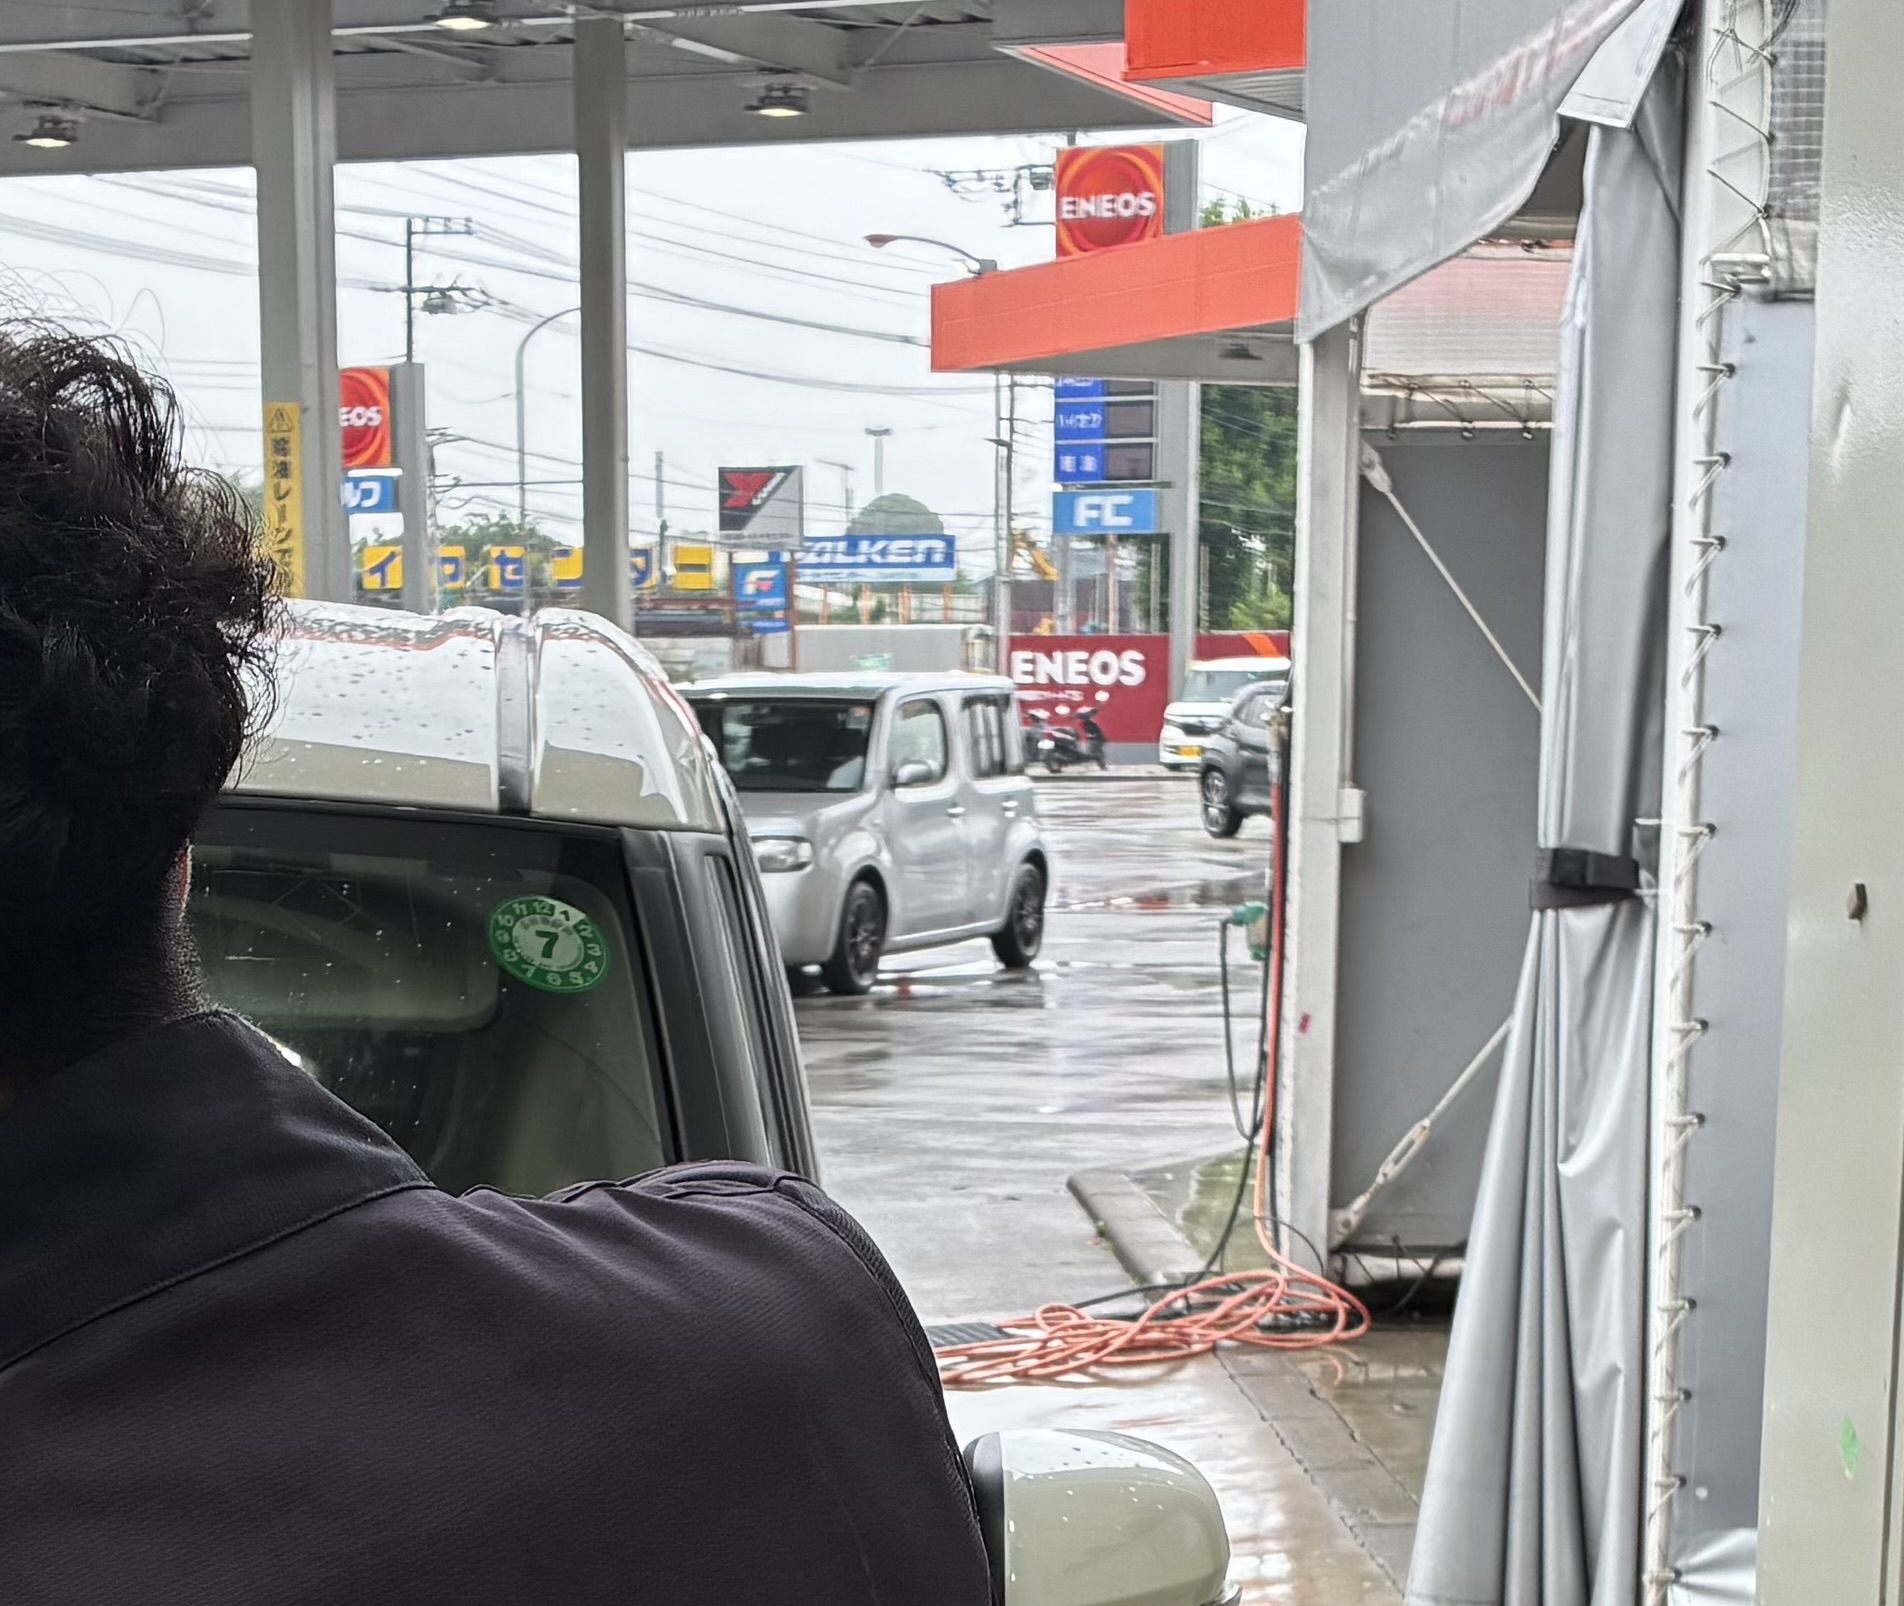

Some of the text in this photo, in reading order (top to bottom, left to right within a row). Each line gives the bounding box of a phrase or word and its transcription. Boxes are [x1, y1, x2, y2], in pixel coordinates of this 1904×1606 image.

[1061, 191, 1156, 219] ENEOS
[339, 405, 383, 427] EOS
[1011, 650, 1146, 686] ENEOS
[512, 903, 528, 915] 11
[533, 901, 552, 914] 12
[497, 915, 514, 927] 10
[559, 910, 570, 921] 1
[578, 924, 593, 938] 2
[535, 930, 559, 959] 7
[586, 943, 602, 956] 3
[503, 949, 518, 962] 8
[521, 964, 536, 977] 7
[584, 961, 598, 973] 4
[546, 972, 562, 985] 6
[569, 971, 584, 984] 5
